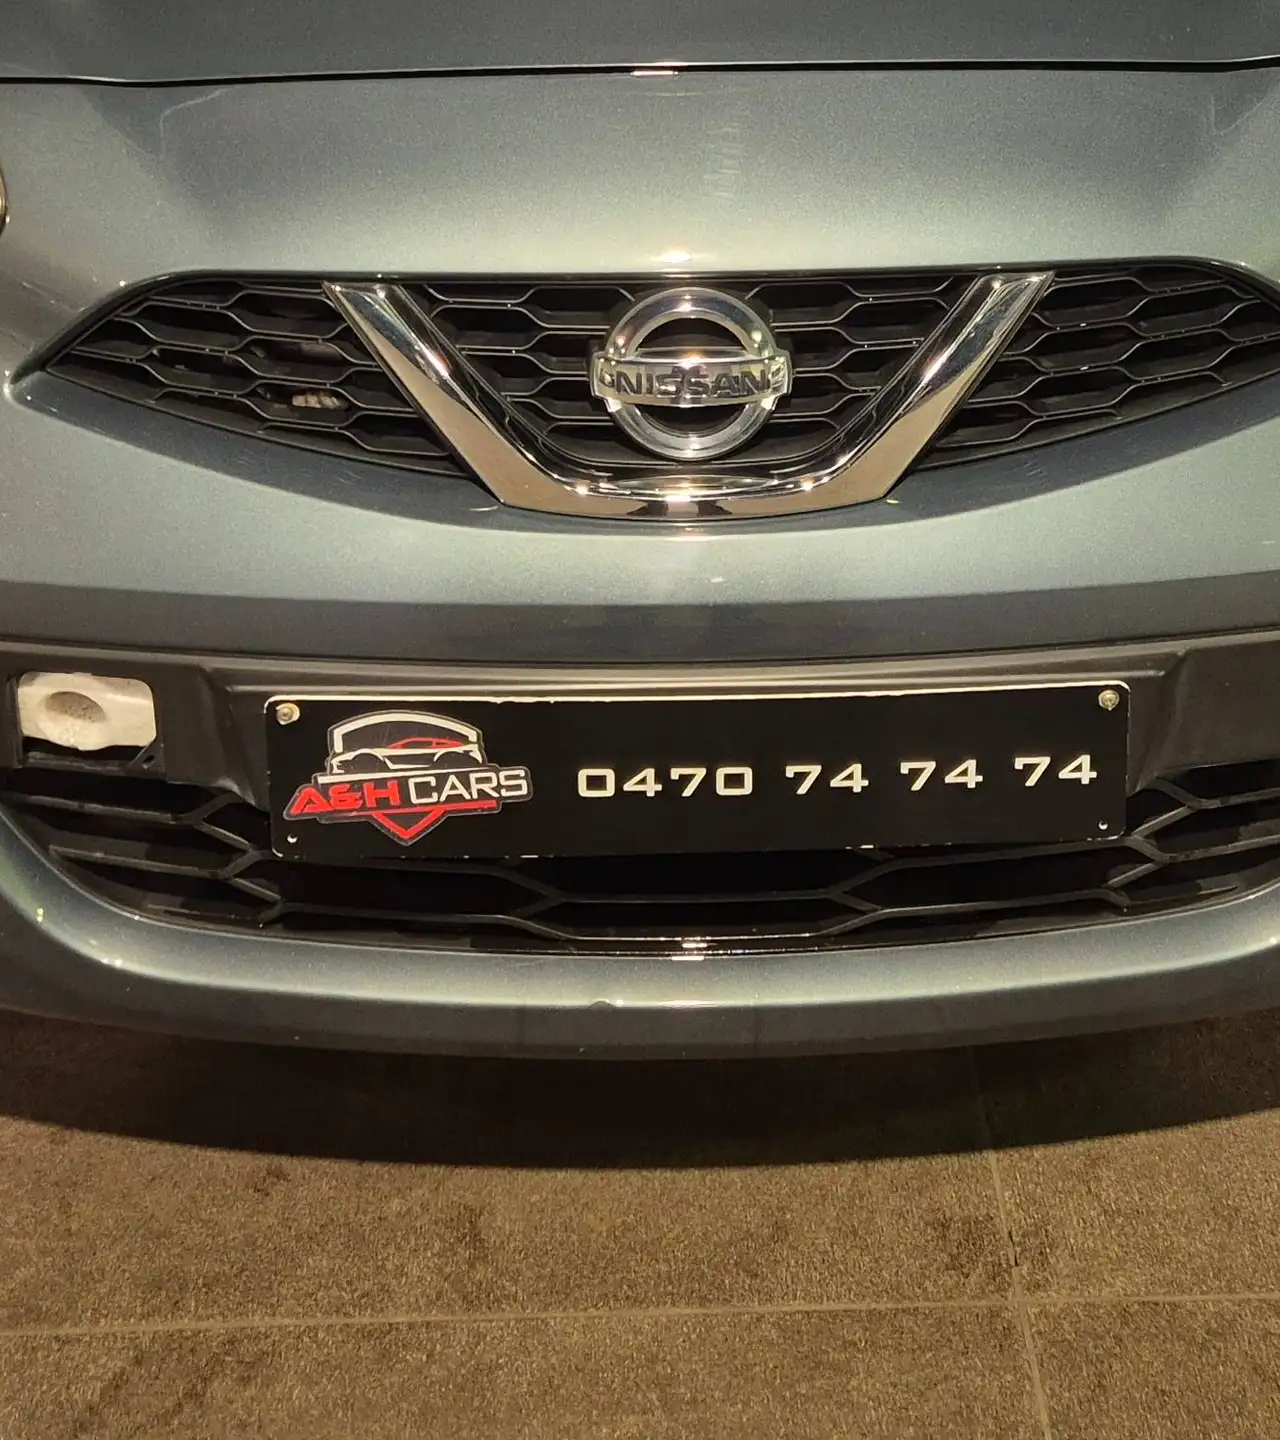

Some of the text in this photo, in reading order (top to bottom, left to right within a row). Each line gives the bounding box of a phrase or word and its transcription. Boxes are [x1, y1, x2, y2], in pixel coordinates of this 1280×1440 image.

[614, 367, 771, 398] NISSAN
[289, 767, 528, 816] A&H CARS
[577, 754, 1098, 798] 0470 74 74 74
